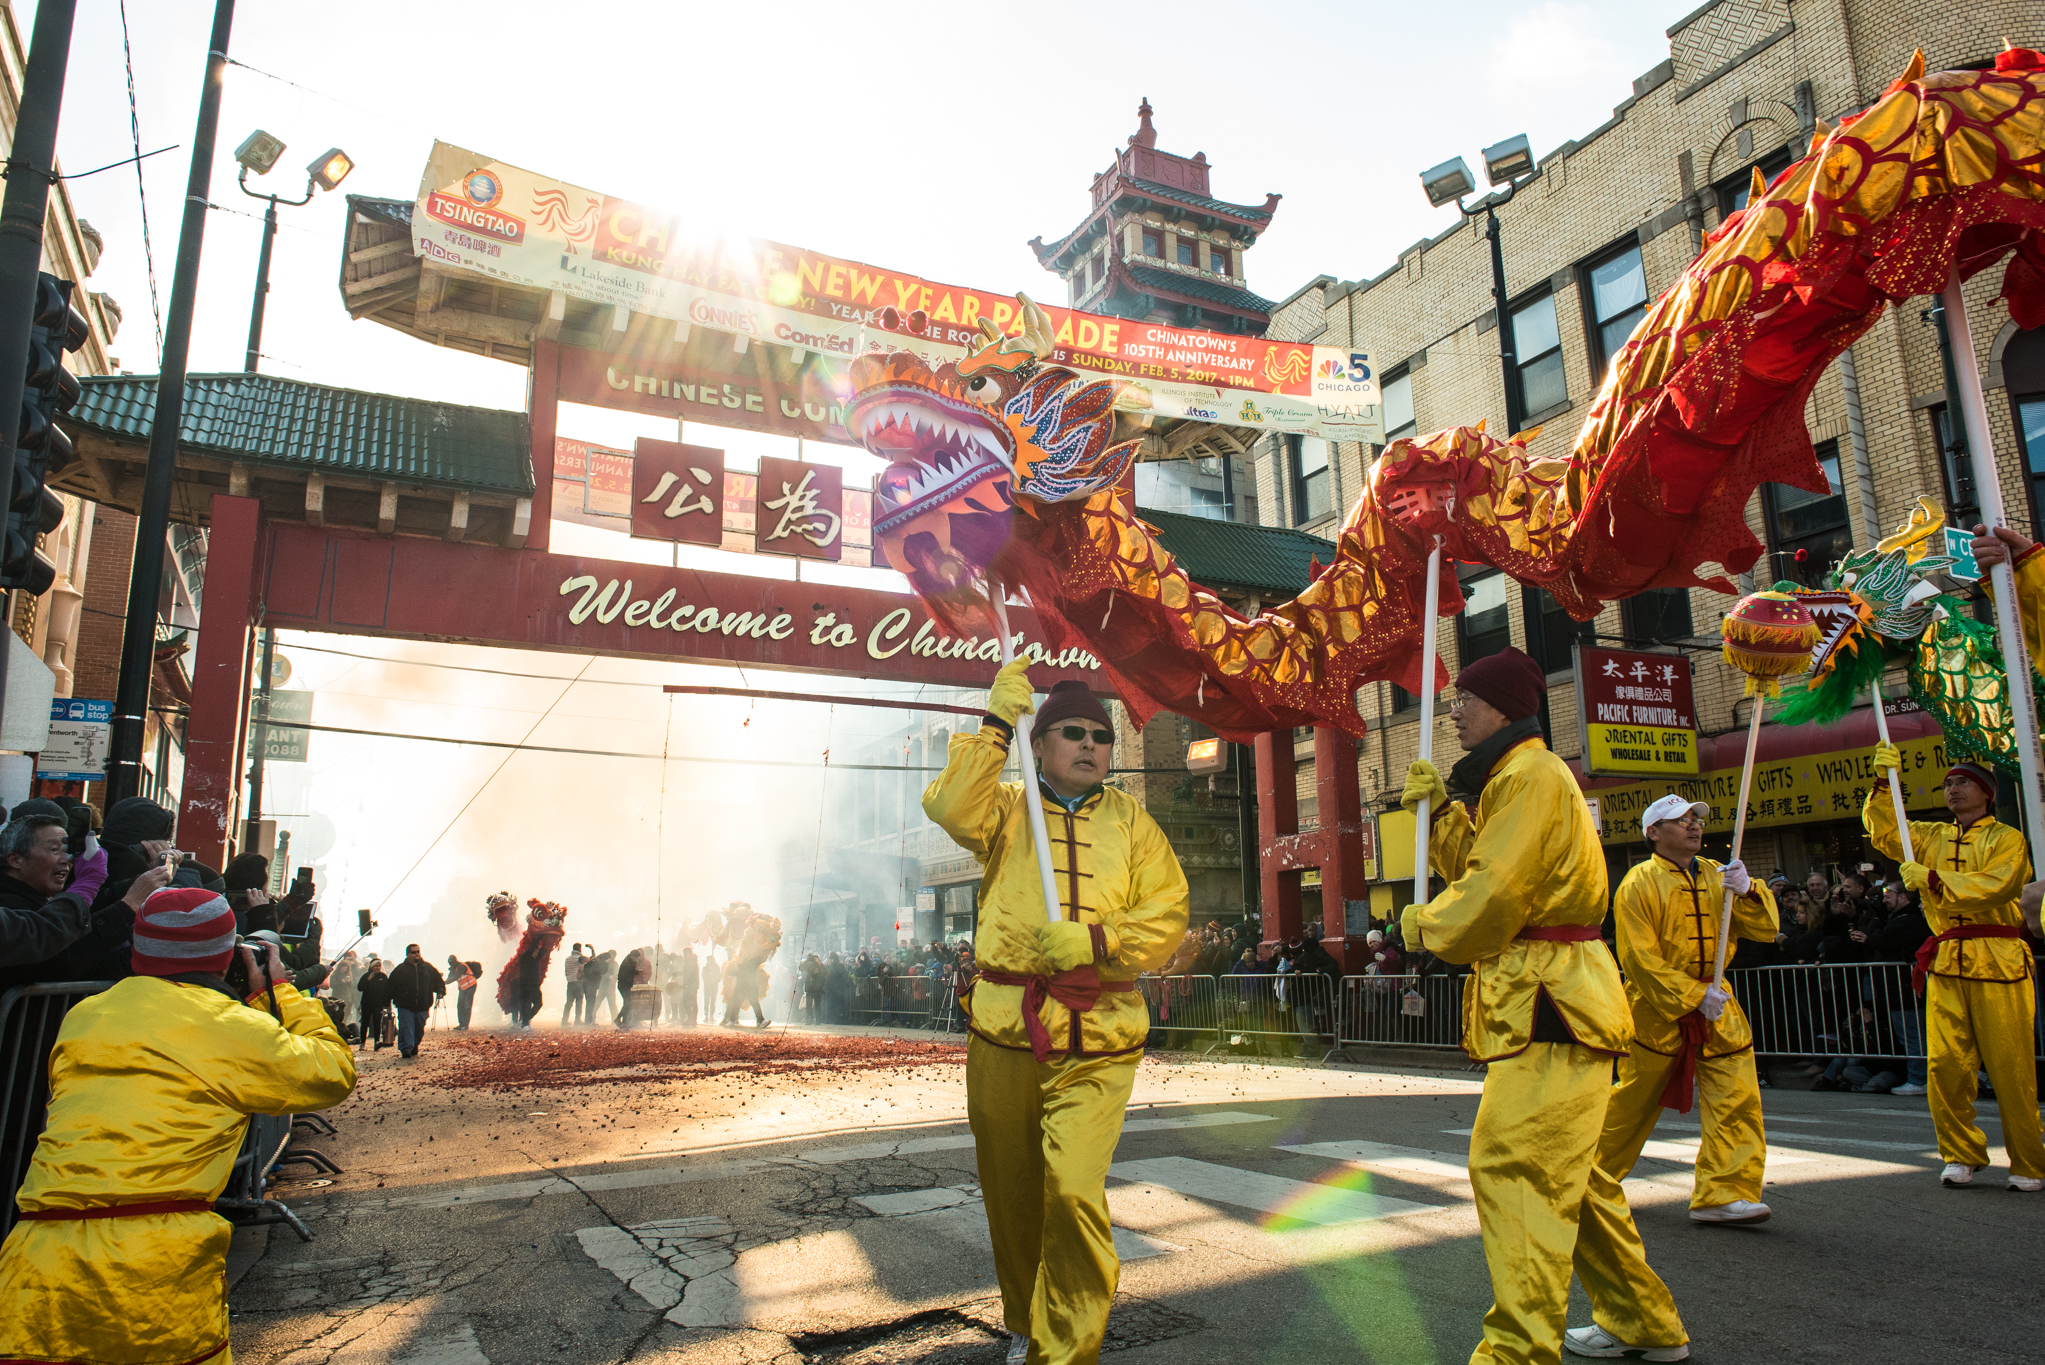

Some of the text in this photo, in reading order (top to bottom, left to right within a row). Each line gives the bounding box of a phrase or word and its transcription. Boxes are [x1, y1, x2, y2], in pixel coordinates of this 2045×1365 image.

[434, 197, 518, 237] TSINGTAO
[422, 239, 460, 263] ADG
[443, 230, 502, 258] 青島啤酒
[581, 267, 667, 299] Lakeside Bank
[596, 284, 620, 297] about
[606, 246, 816, 311] KUNG HAY FAT CY!
[609, 209, 1120, 354] CHNE NEW YEAR PAADE
[830, 303, 875, 325] YEAR
[919, 324, 941, 339] HE
[774, 322, 855, 355] ComEd
[1146, 329, 1237, 353] CHINATOWN'S
[1123, 342, 1255, 371] 105TH ANNIVERSARY
[1347, 353, 1371, 383] 5
[1072, 353, 1255, 388] SUNDAY, FEB. 5, 2017 1PM
[606, 362, 765, 413] CHINESE
[1161, 388, 1216, 400] ILLINOIS INSTITUTE
[1318, 382, 1371, 392] CHICAGO
[1181, 406, 1209, 419] ultra
[1195, 398, 1233, 408] TECHNOLOGY
[1262, 406, 1286, 418] Triple
[1317, 403, 1376, 421] HYATT
[1328, 427, 1374, 436] ASIAN-PACIFIC
[1334, 433, 1370, 441] ISLANDERS
[641, 467, 715, 519] 公
[559, 575, 1102, 672] Welcome to Chinatown
[1602, 658, 1680, 686] 太平洋
[1615, 685, 1673, 703] 傢俱禮品公司
[87, 702, 106, 711] bus
[87, 711, 109, 721] stop
[1597, 703, 1691, 727] PACIFIC FURNITURE INC.
[1884, 701, 1919, 715] DR. SUN
[1604, 728, 1689, 748] ORIENTAL GIFTS
[1610, 748, 1687, 763] WHOLESALE & RETAIL
[1603, 788, 1653, 814] ORIENTAL
[1665, 776, 1736, 803] FURNITURE
[1758, 766, 1794, 793] GIFTS
[1915, 751, 1927, 770] &
